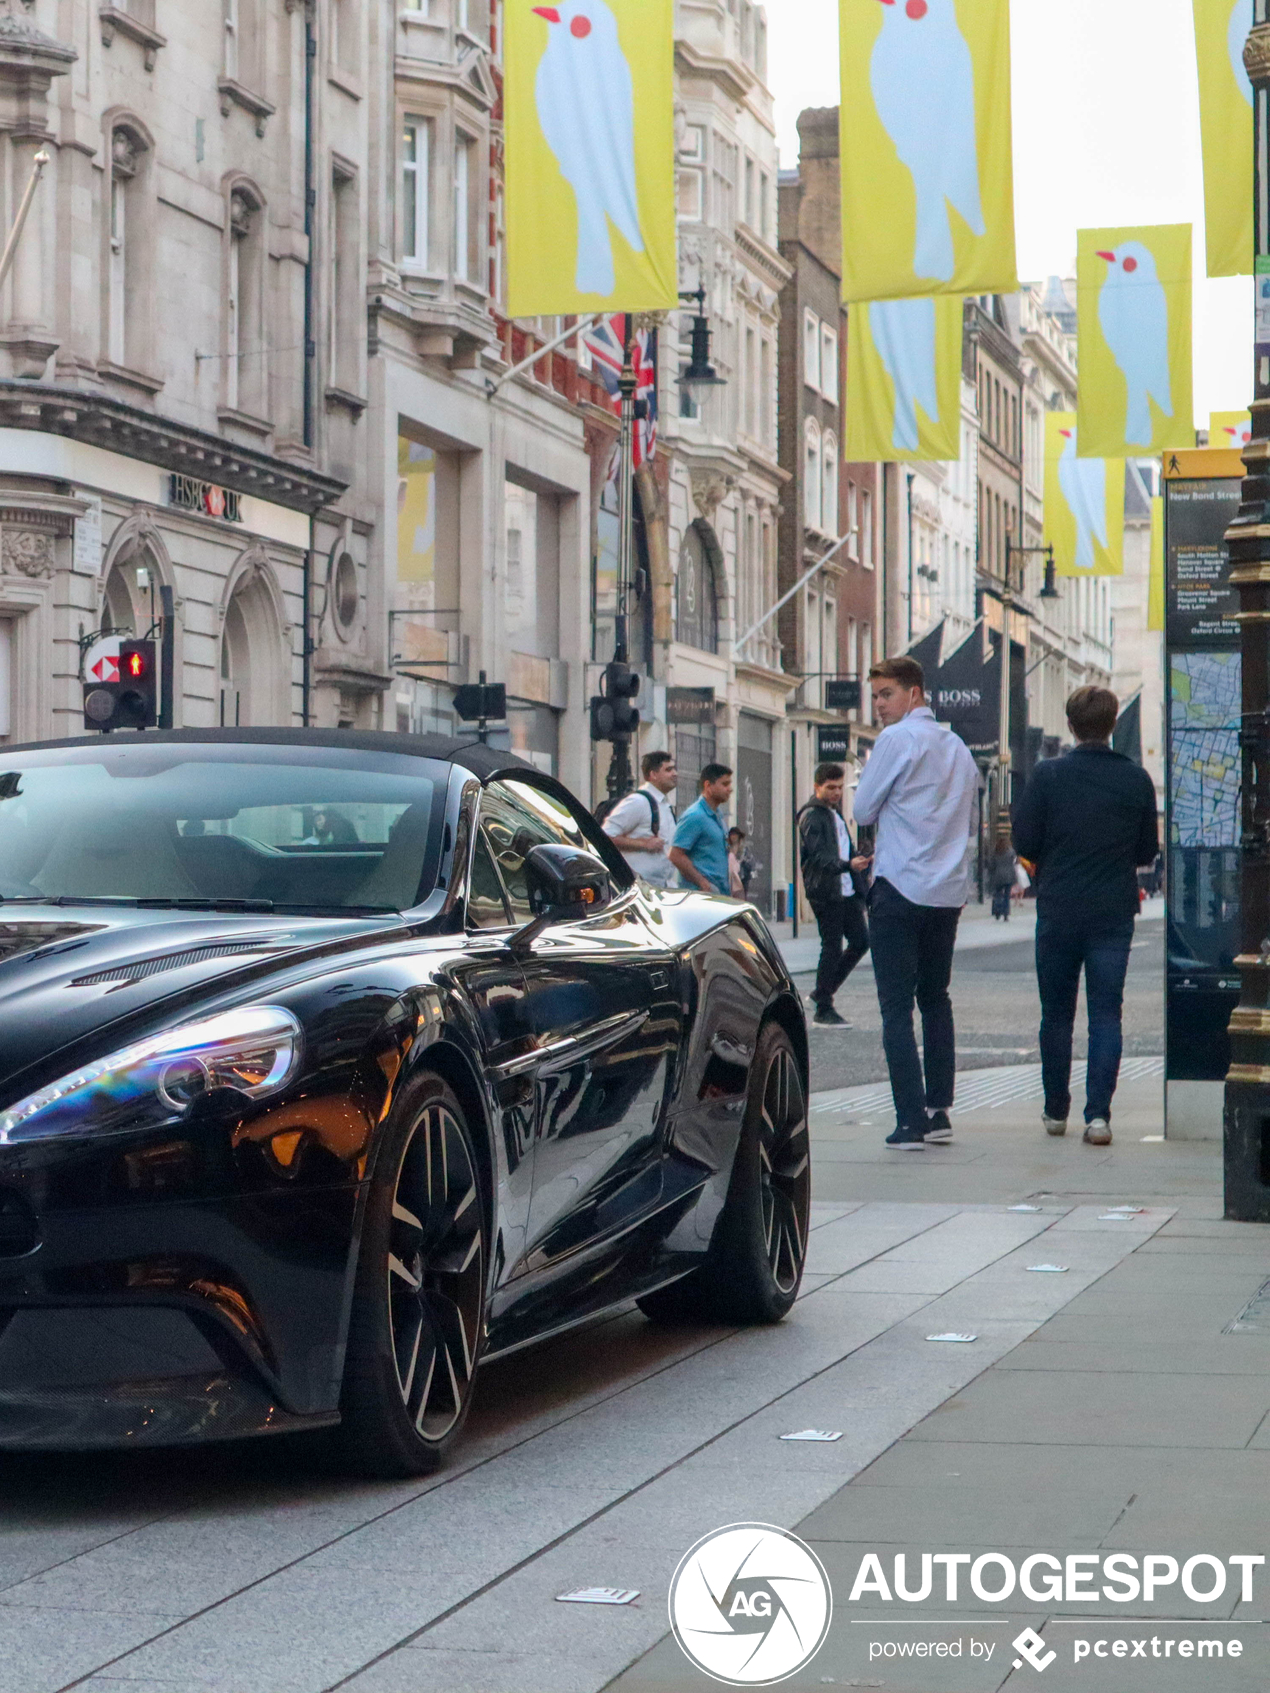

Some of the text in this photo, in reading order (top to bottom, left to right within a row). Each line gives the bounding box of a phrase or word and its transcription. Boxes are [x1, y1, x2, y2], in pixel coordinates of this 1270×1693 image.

[1193, 492, 1215, 500] Bond
[938, 688, 981, 703] BOSS
[822, 741, 847, 749] BOSS
